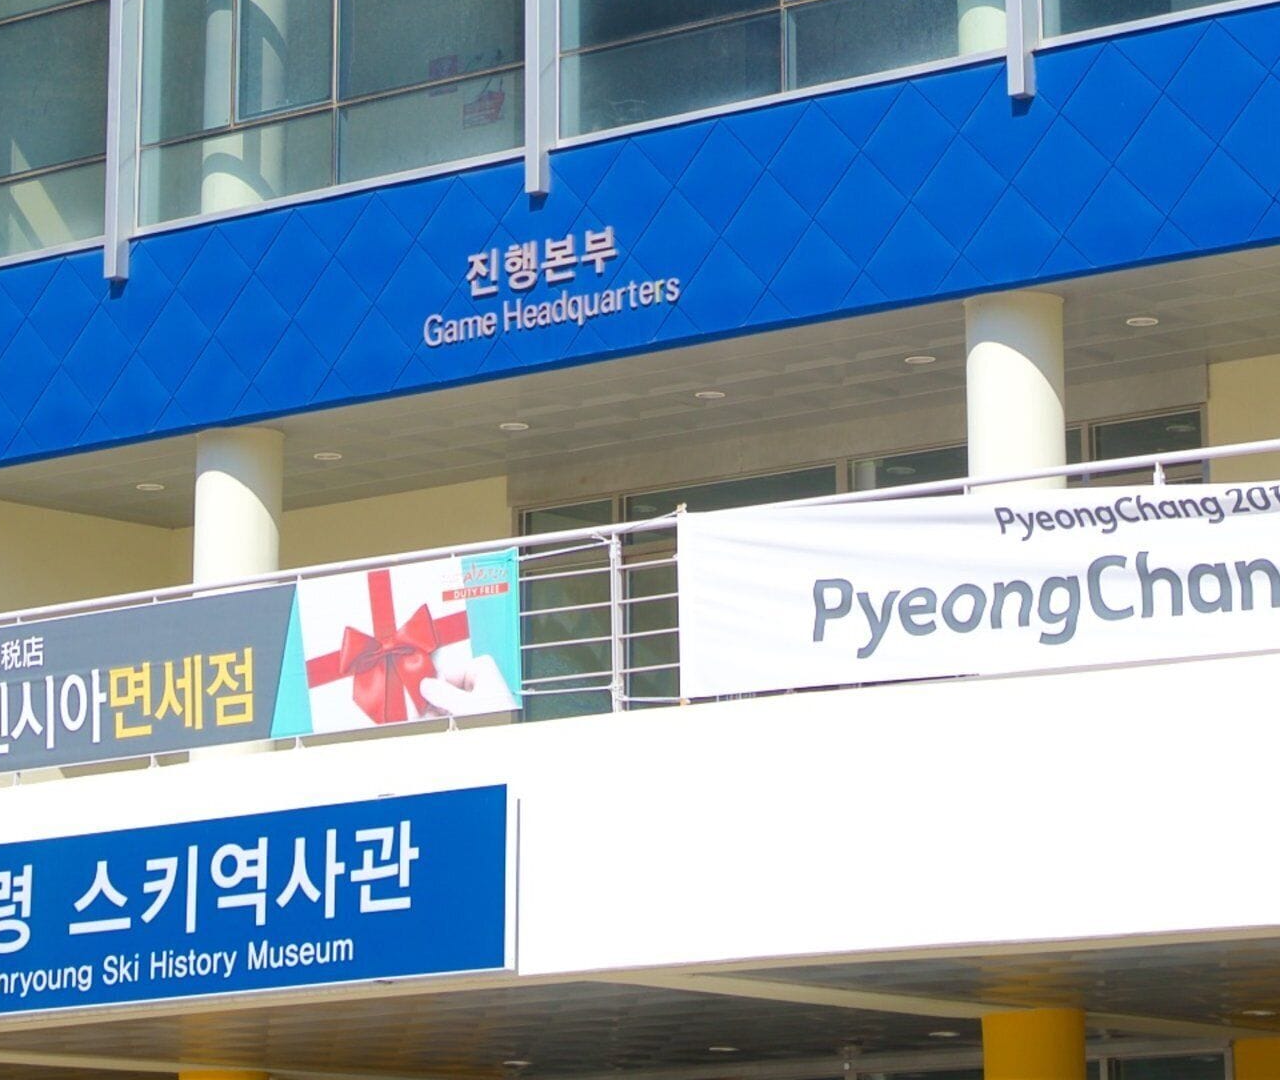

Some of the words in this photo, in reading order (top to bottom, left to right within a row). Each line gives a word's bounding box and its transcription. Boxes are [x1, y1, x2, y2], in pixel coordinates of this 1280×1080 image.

[466, 226, 618, 298] 진행본부
[423, 311, 498, 347] Game
[503, 276, 681, 332] Headquarters
[995, 495, 1224, 541] PyeongChang
[453, 586, 477, 599] DUTY
[480, 584, 499, 595] FREE
[67, 819, 420, 938] 스키역사관
[102, 953, 140, 984] Ski
[150, 944, 238, 981] History
[247, 934, 355, 970] Museum
